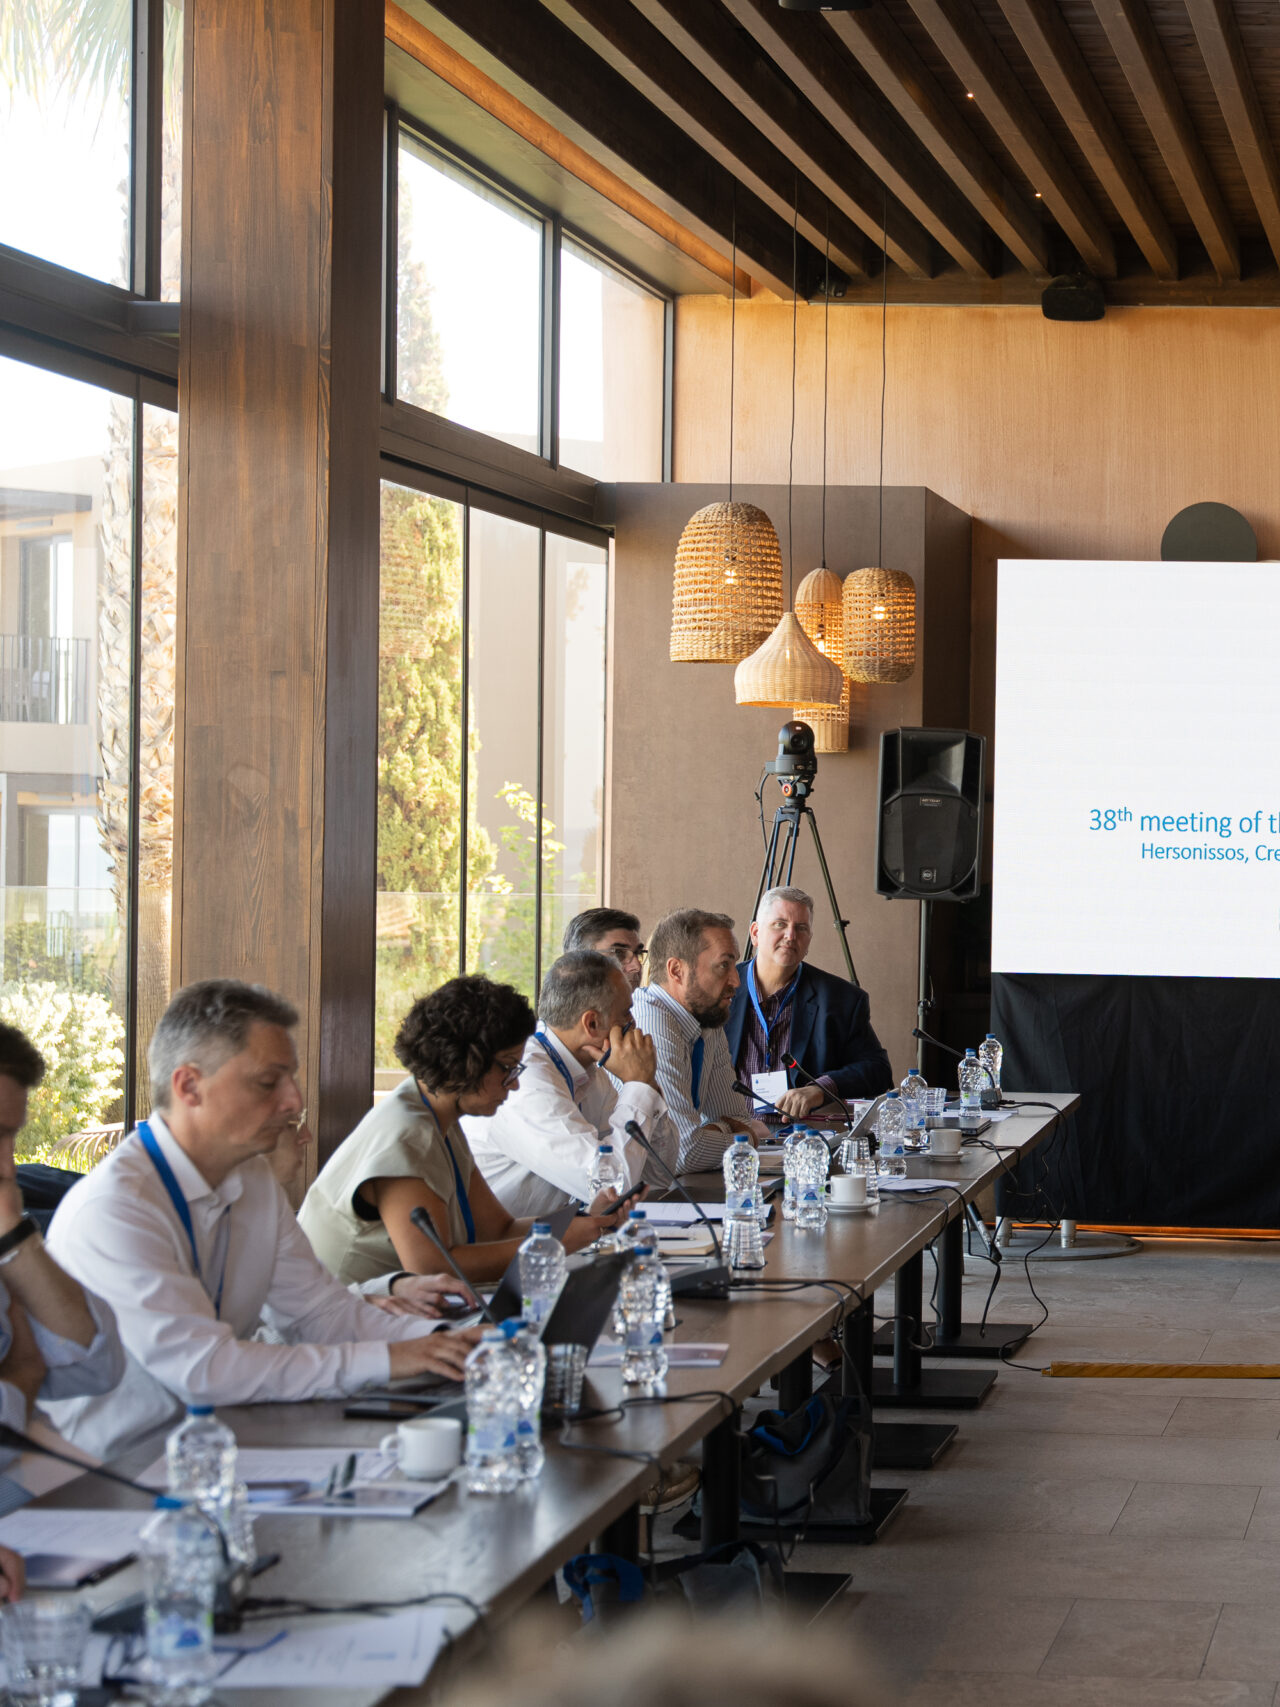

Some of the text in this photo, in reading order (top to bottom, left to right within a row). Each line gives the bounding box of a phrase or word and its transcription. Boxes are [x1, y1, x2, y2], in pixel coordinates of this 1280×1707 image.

[1140, 811, 1233, 838] meeting
[1239, 810, 1264, 834] of
[1141, 842, 1249, 864] Hersonissos,
